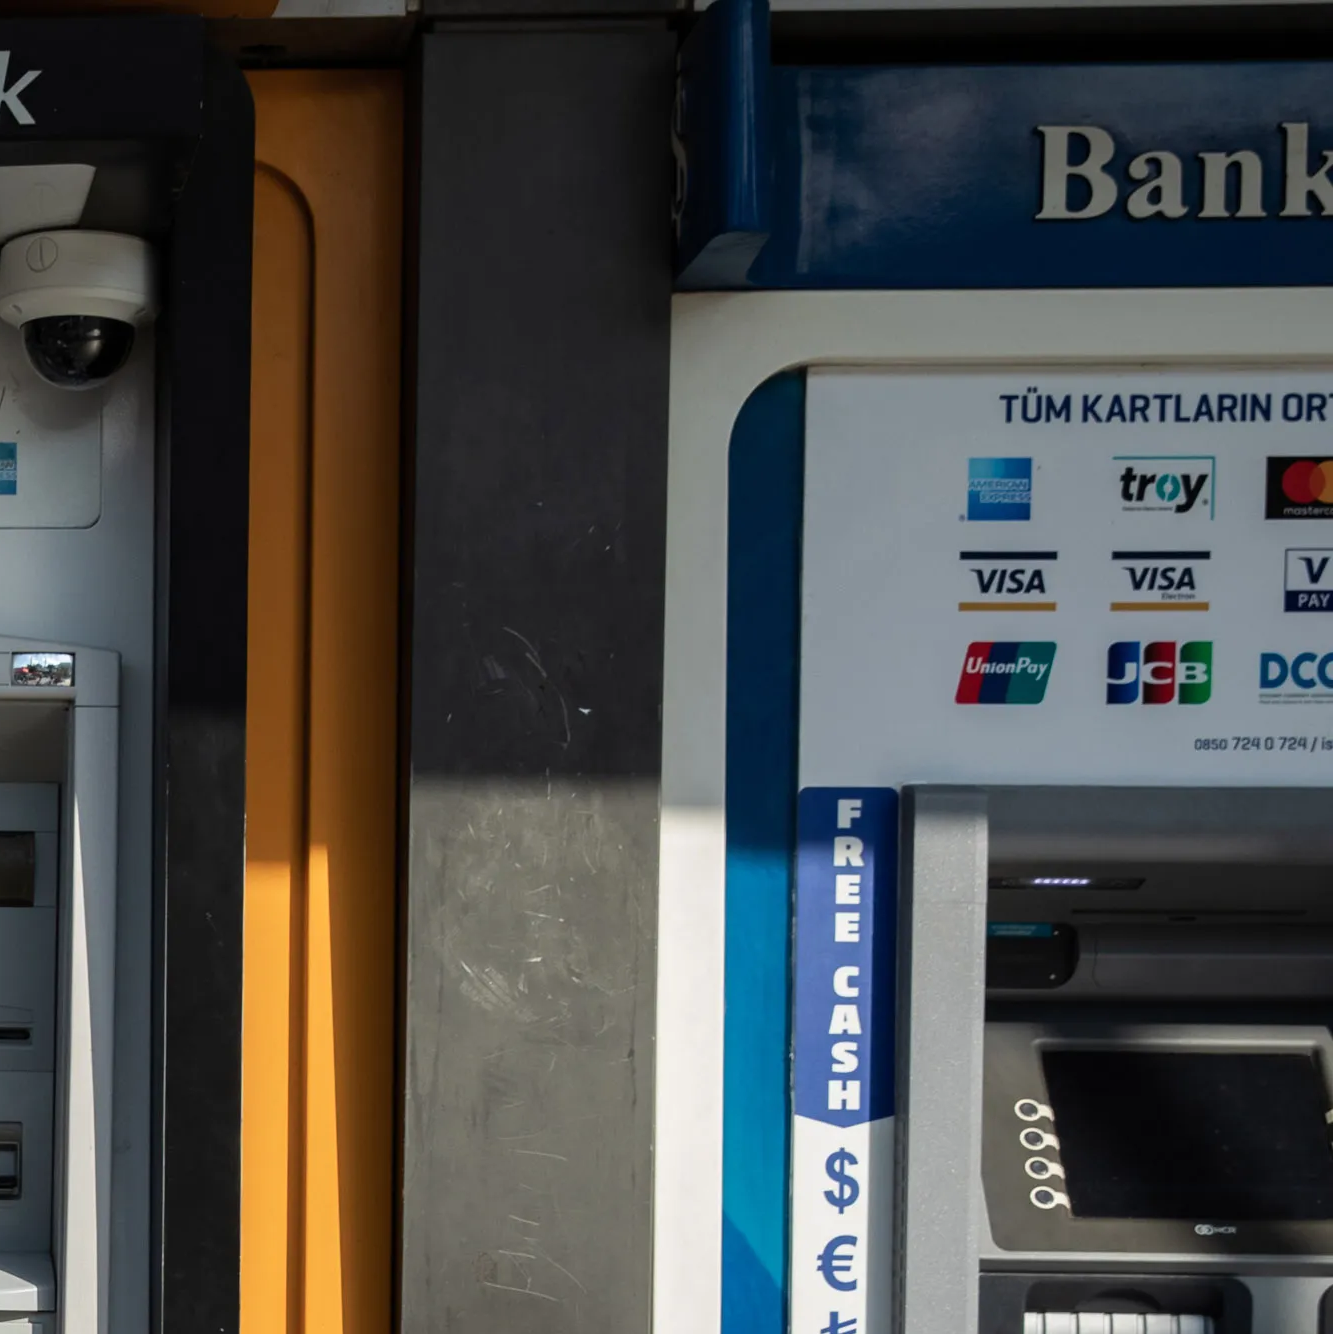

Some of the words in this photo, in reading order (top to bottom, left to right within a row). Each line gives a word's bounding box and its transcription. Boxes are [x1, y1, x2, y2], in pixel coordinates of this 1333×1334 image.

[999, 387, 1072, 423] TÜM
[1082, 393, 1272, 423] KARTLARIN
[968, 479, 1029, 490] AMERICAN
[1120, 467, 1209, 513] troy
[970, 569, 1046, 594] VISA
[1123, 567, 1196, 591] VISA
[1161, 592, 1196, 600] Electron
[1297, 593, 1330, 608] PAY
[965, 656, 1050, 681] UnionPay
[1106, 661, 1210, 685] JCB
[1194, 738, 1228, 751] 0850
[1231, 736, 1261, 751] 724
[1264, 736, 1275, 751] 0
[1278, 736, 1308, 751] 724
[833, 798, 865, 944] FREE
[827, 964, 864, 1111] CASH
